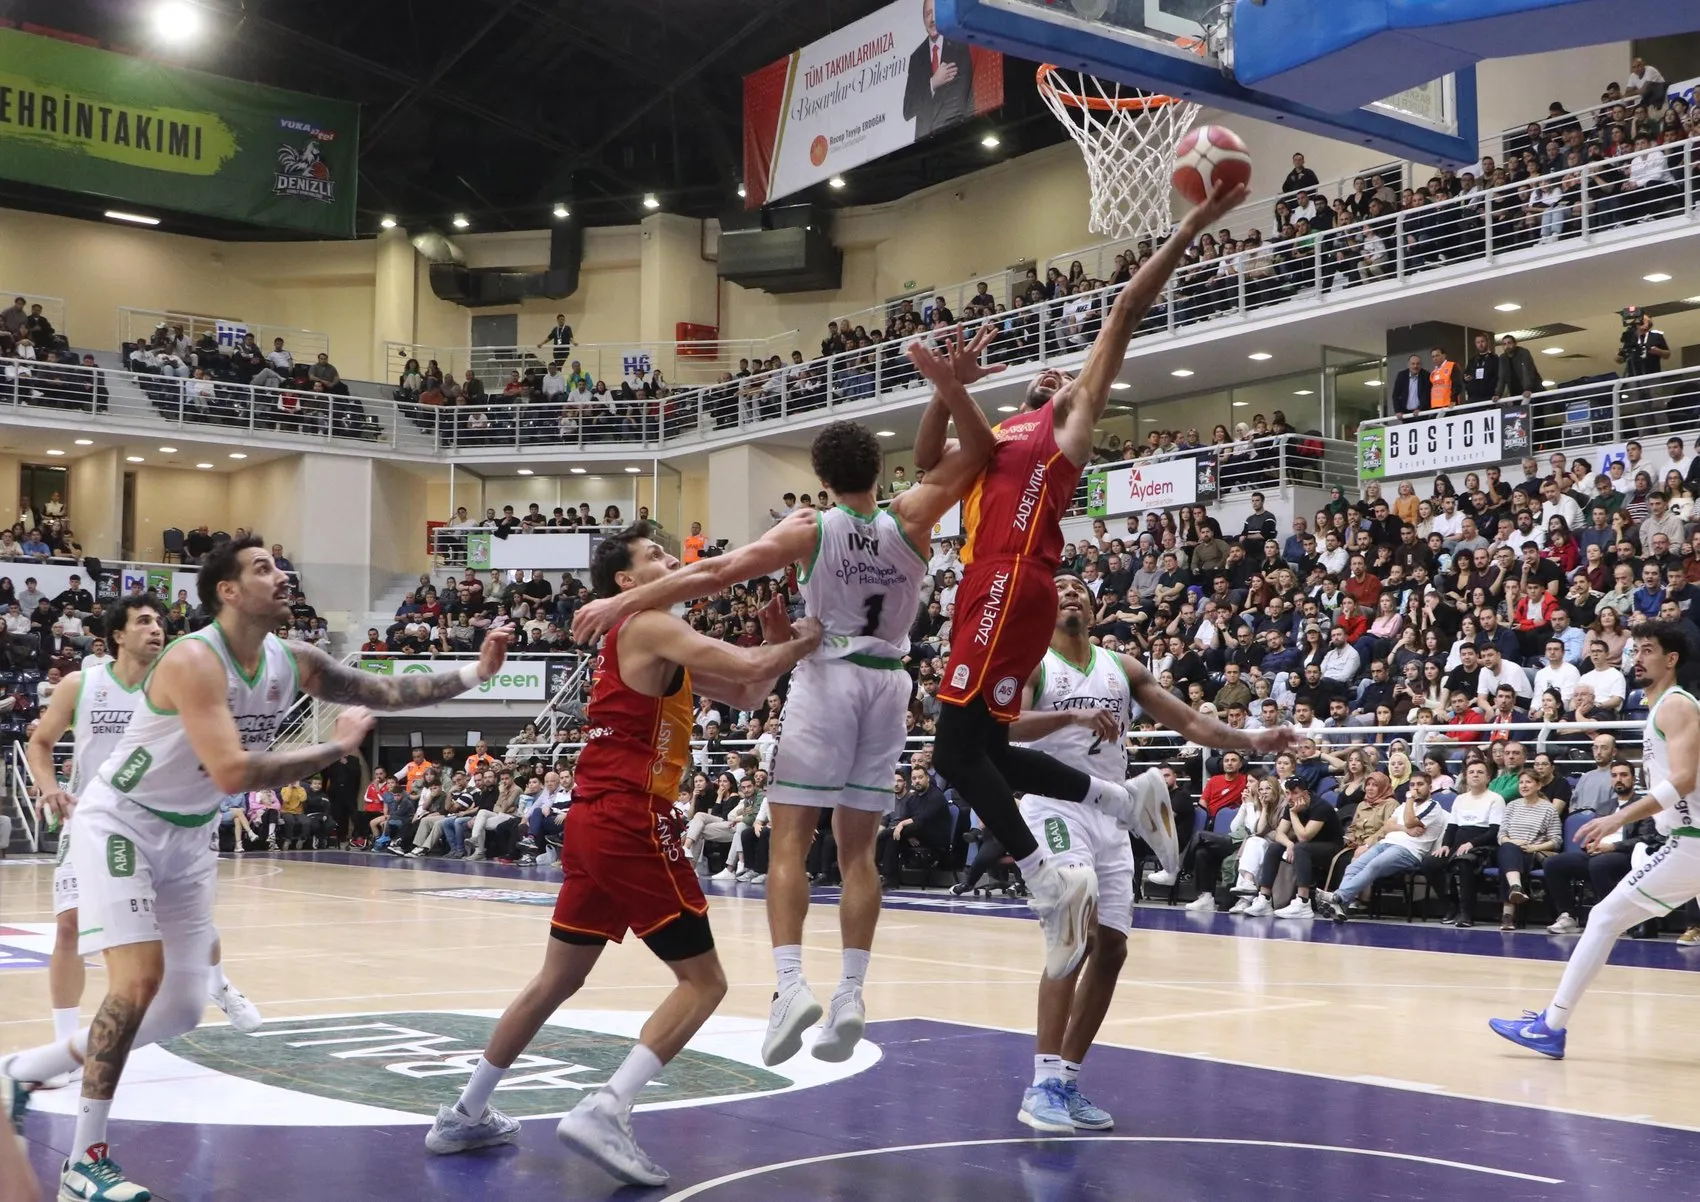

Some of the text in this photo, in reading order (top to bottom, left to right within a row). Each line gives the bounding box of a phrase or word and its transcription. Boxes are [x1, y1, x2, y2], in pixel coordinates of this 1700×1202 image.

[804, 32, 894, 90] TÜM TAKIMLARIMIZA
[852, 55, 906, 93] Dilerim
[862, 113, 886, 131] ERDOĞAN
[623, 355, 651, 375] H6
[1390, 416, 1495, 458] BOSTON
[1130, 481, 1173, 501] Aydem
[862, 594, 885, 636] 1
[478, 673, 539, 692] green
[998, 684, 1013, 696] AVS
[116, 752, 147, 787] ABALI
[1049, 820, 1065, 849] ABALI
[114, 840, 128, 872] ABALI
